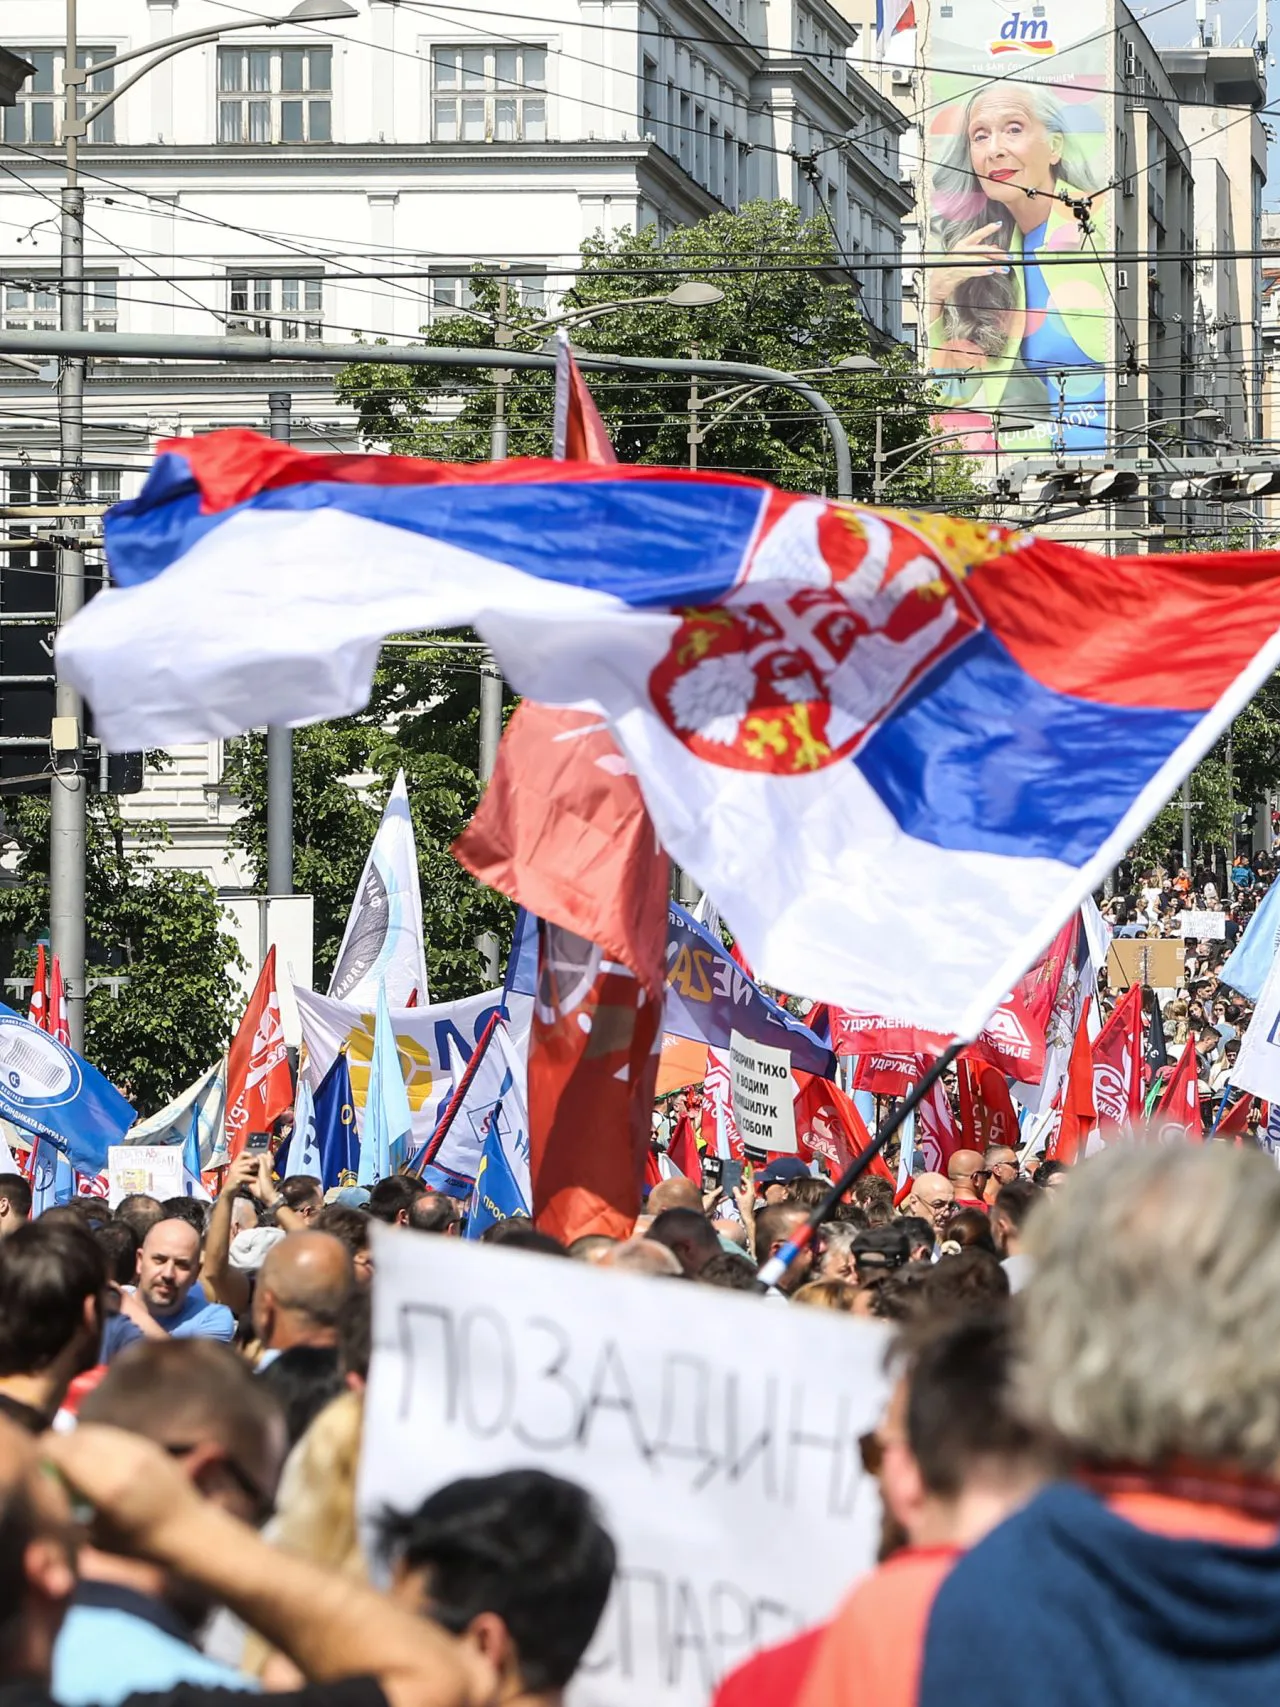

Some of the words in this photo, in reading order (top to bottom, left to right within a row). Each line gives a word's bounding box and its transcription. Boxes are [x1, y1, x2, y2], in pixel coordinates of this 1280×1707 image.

[1000, 12, 1048, 40] dm
[757, 1062, 788, 1079] ТИХО
[740, 1075, 769, 1096] ВОДИМ
[3, 1104, 38, 1129] СИНДИКАТА
[37, 1120, 69, 1146] БЕОГРАДА
[742, 1118, 773, 1138] СОБОМ
